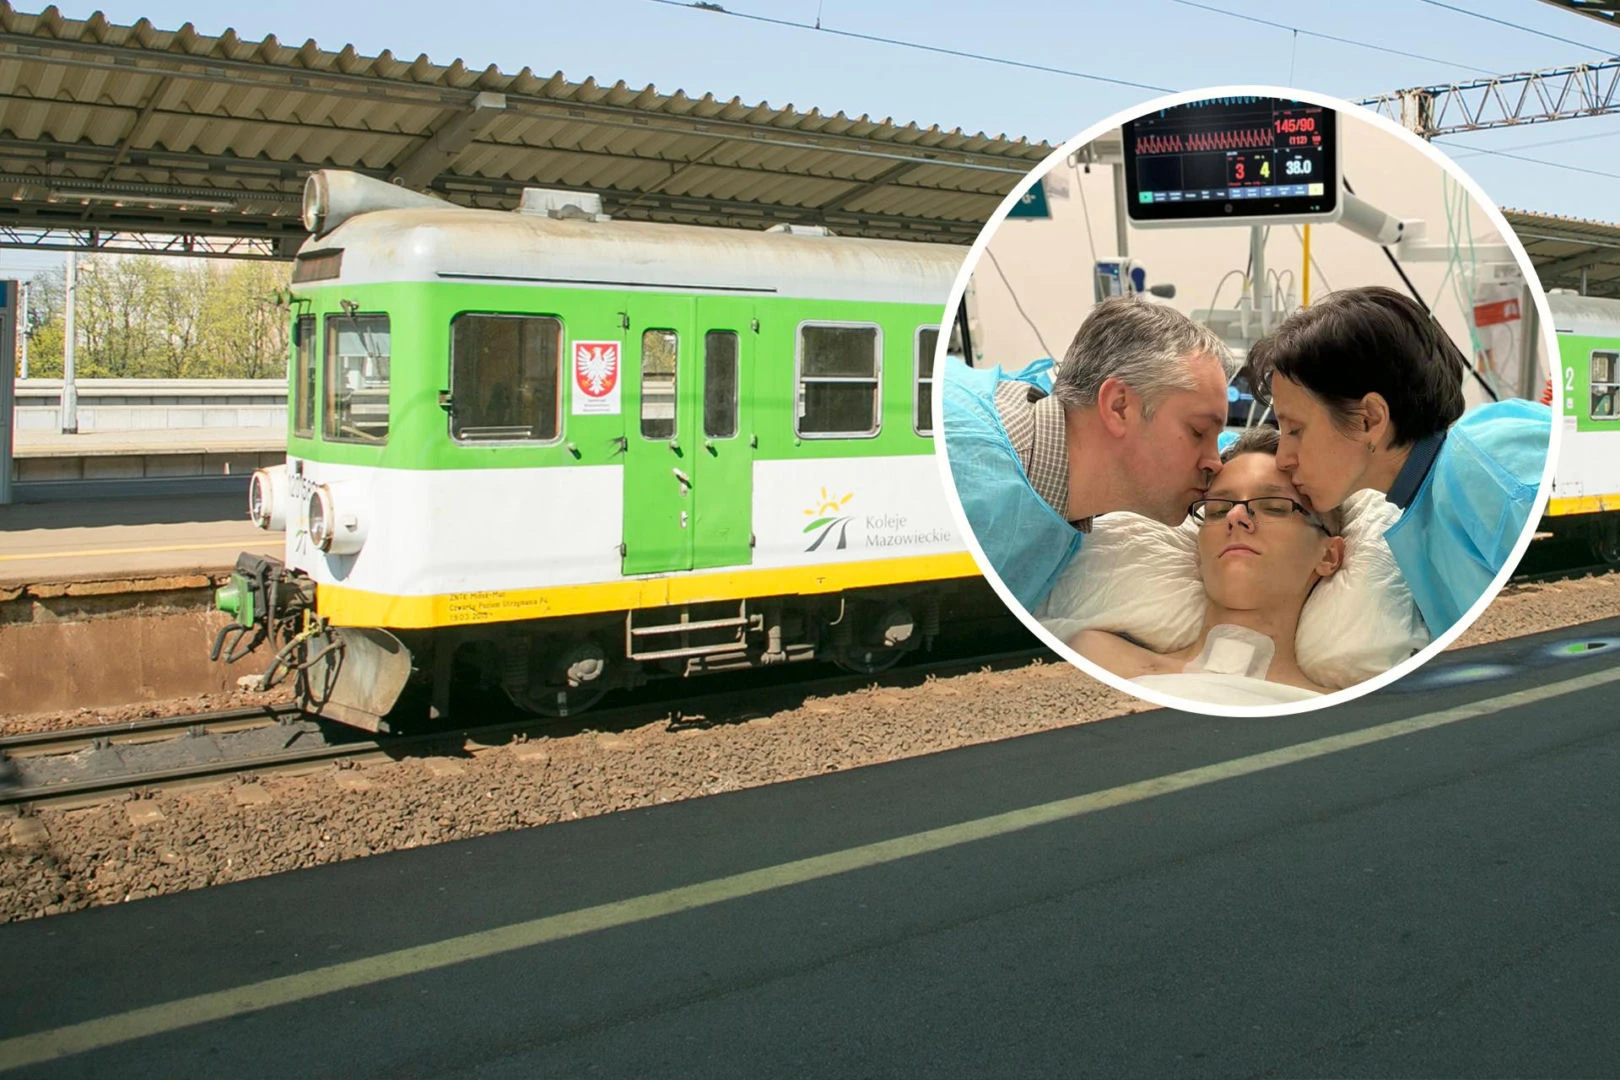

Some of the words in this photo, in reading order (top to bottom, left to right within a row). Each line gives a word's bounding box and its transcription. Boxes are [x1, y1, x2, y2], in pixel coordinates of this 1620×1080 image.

[1274, 117, 1315, 134] 145/90
[1235, 163, 1245, 180] 3
[1259, 161, 1270, 178] 4
[1286, 160, 1312, 175] 38.0
[1565, 366, 1574, 391] 2
[866, 512, 907, 531] Koleje
[865, 527, 951, 548] Mazowieckie
